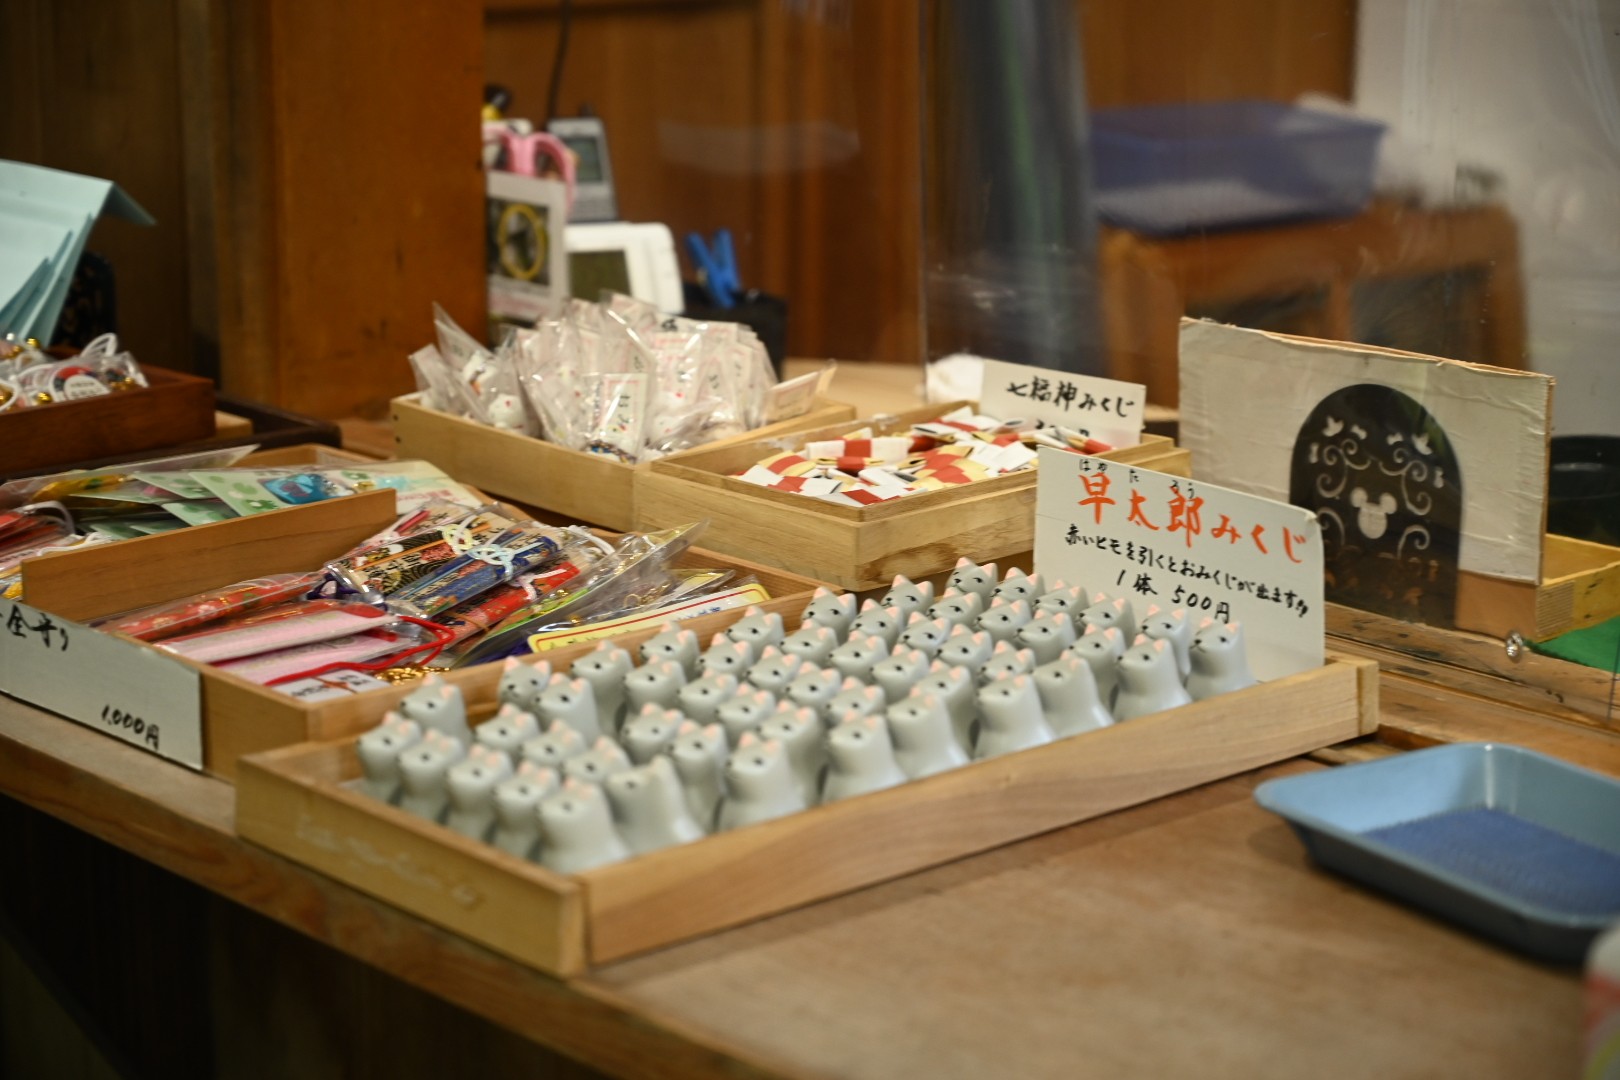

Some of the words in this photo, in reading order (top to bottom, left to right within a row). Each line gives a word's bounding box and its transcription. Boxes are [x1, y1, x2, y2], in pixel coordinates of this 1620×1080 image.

[1007, 376, 1135, 418] 七福神みくじ
[1078, 471, 1307, 564] 早太郎みくじ
